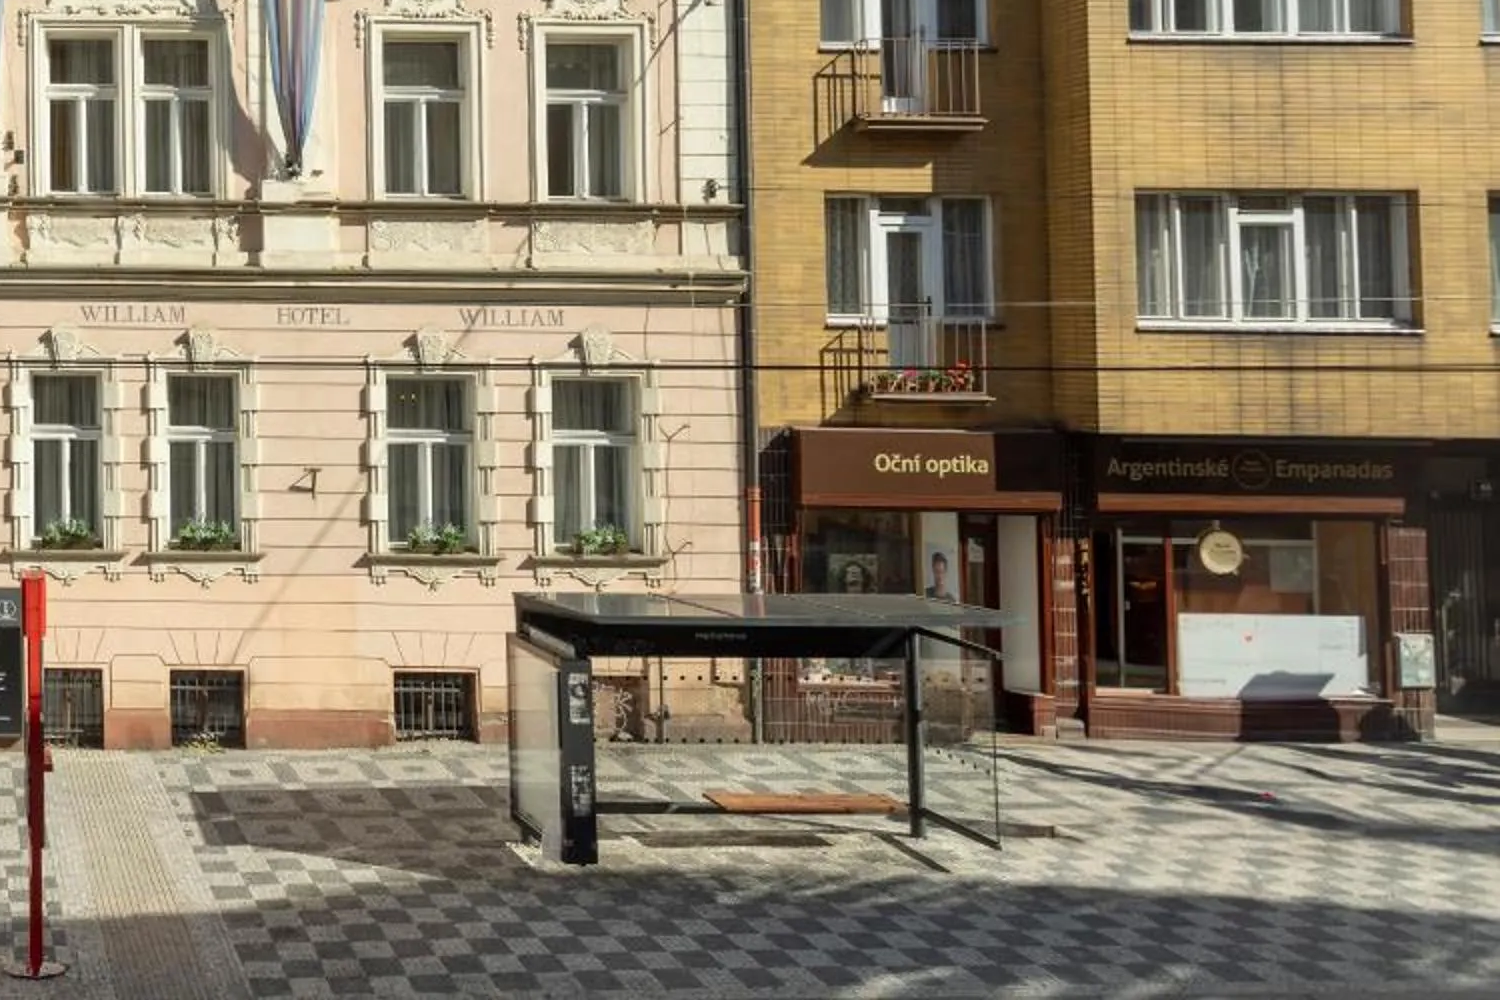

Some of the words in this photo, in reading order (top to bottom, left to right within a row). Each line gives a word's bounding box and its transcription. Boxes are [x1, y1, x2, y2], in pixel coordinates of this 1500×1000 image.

[79, 304, 186, 324] WILLIAM
[275, 306, 350, 326] HOTEL
[459, 307, 565, 327] WILLIAM
[875, 453, 921, 472] Oční
[925, 455, 989, 478] optika
[1107, 458, 1229, 480] Argentinské
[1275, 459, 1394, 482] Empanadas
